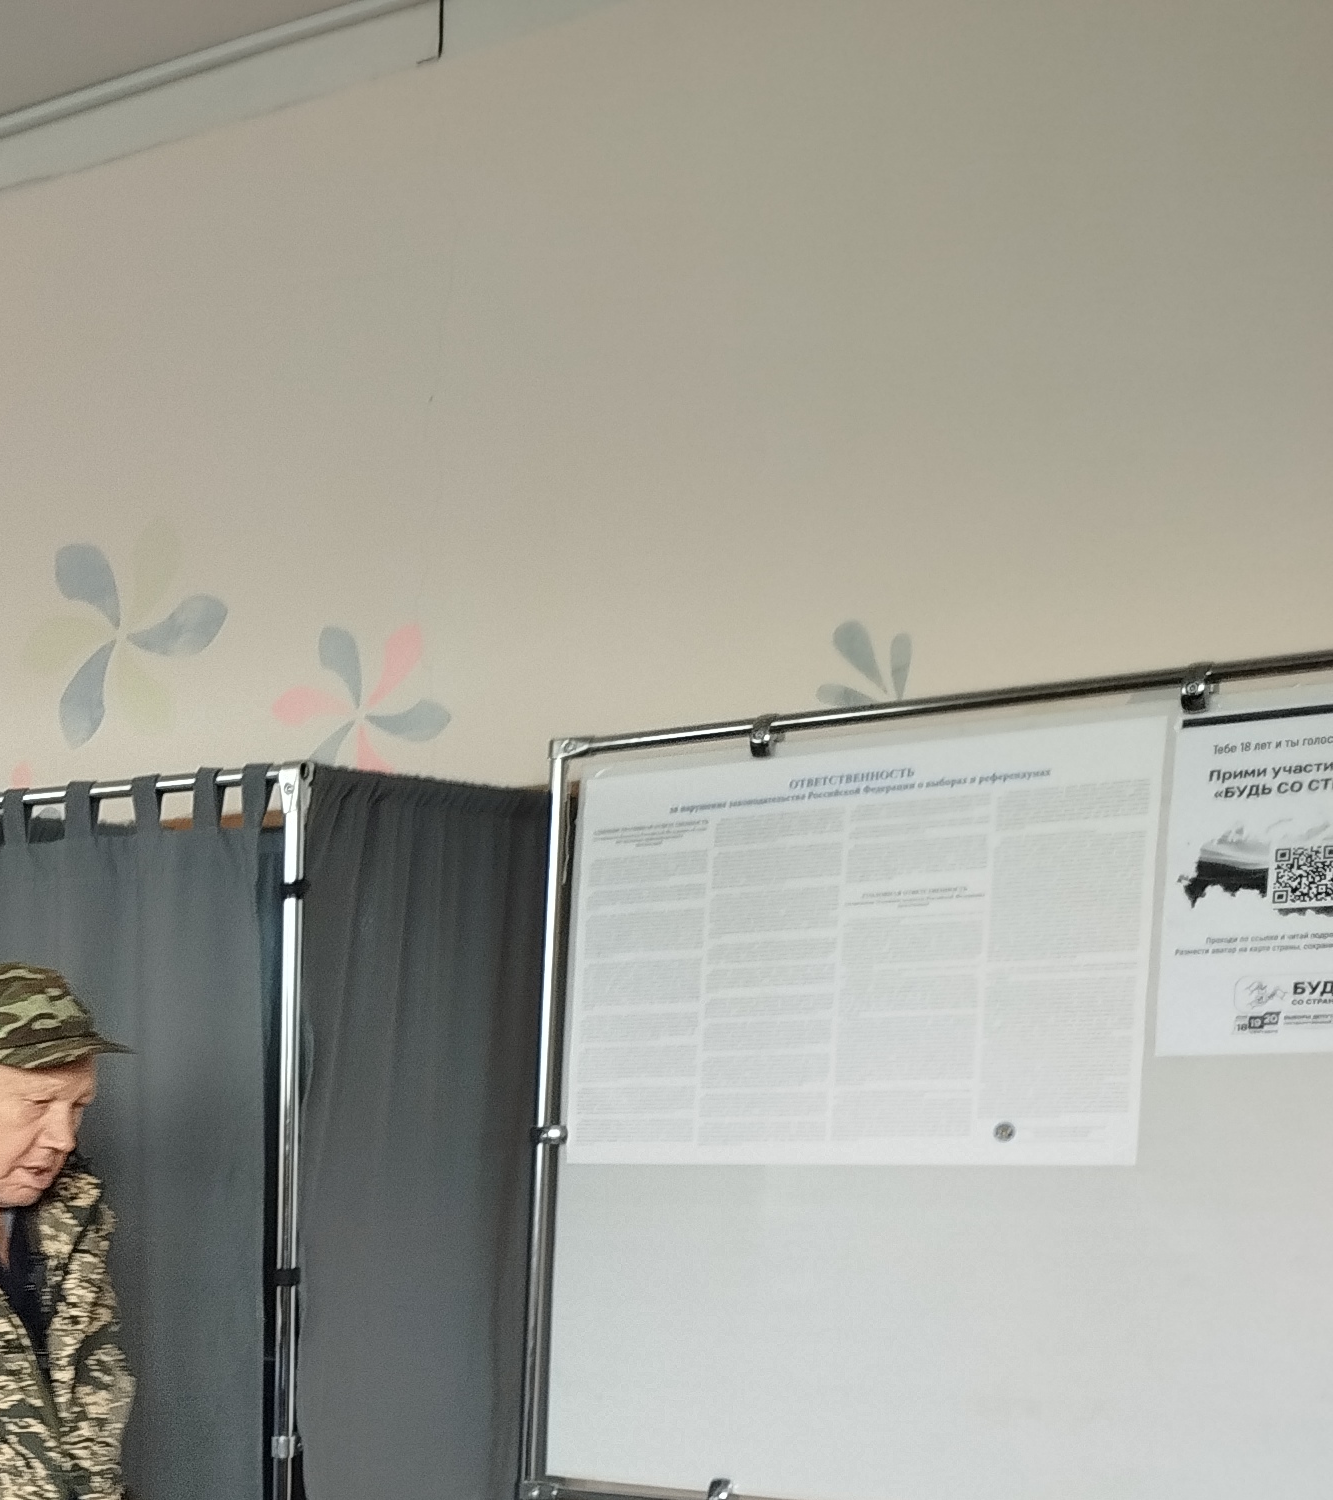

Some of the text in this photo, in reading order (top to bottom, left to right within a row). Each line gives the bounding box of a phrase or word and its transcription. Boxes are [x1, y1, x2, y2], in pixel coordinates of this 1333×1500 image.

[1213, 744, 1237, 755] Тебе
[1240, 741, 1251, 753] 18
[1254, 741, 1272, 751] лет
[1275, 740, 1282, 749] и
[1285, 738, 1299, 748] ты
[789, 768, 915, 790] ОТВЕТСТВЕННОСТЬ
[1209, 767, 1267, 783] Прими
[807, 785, 861, 801] Российской
[1214, 777, 1333, 799] «БУДЬ СО СТ
